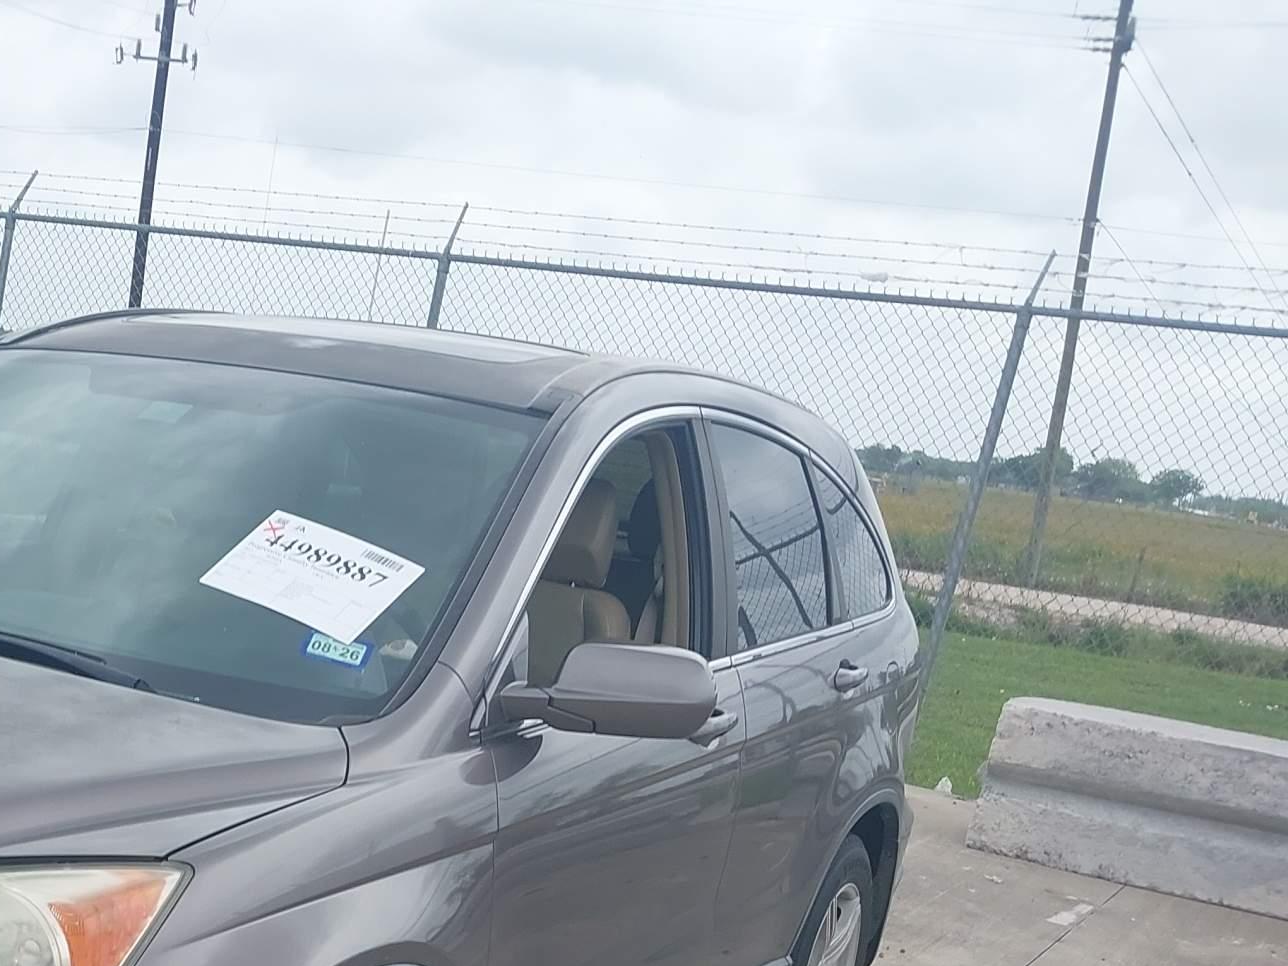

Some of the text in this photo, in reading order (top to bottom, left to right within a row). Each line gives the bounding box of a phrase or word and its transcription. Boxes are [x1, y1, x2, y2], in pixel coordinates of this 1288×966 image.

[265, 533, 389, 588] 44989887
[311, 640, 361, 661] 08 26
